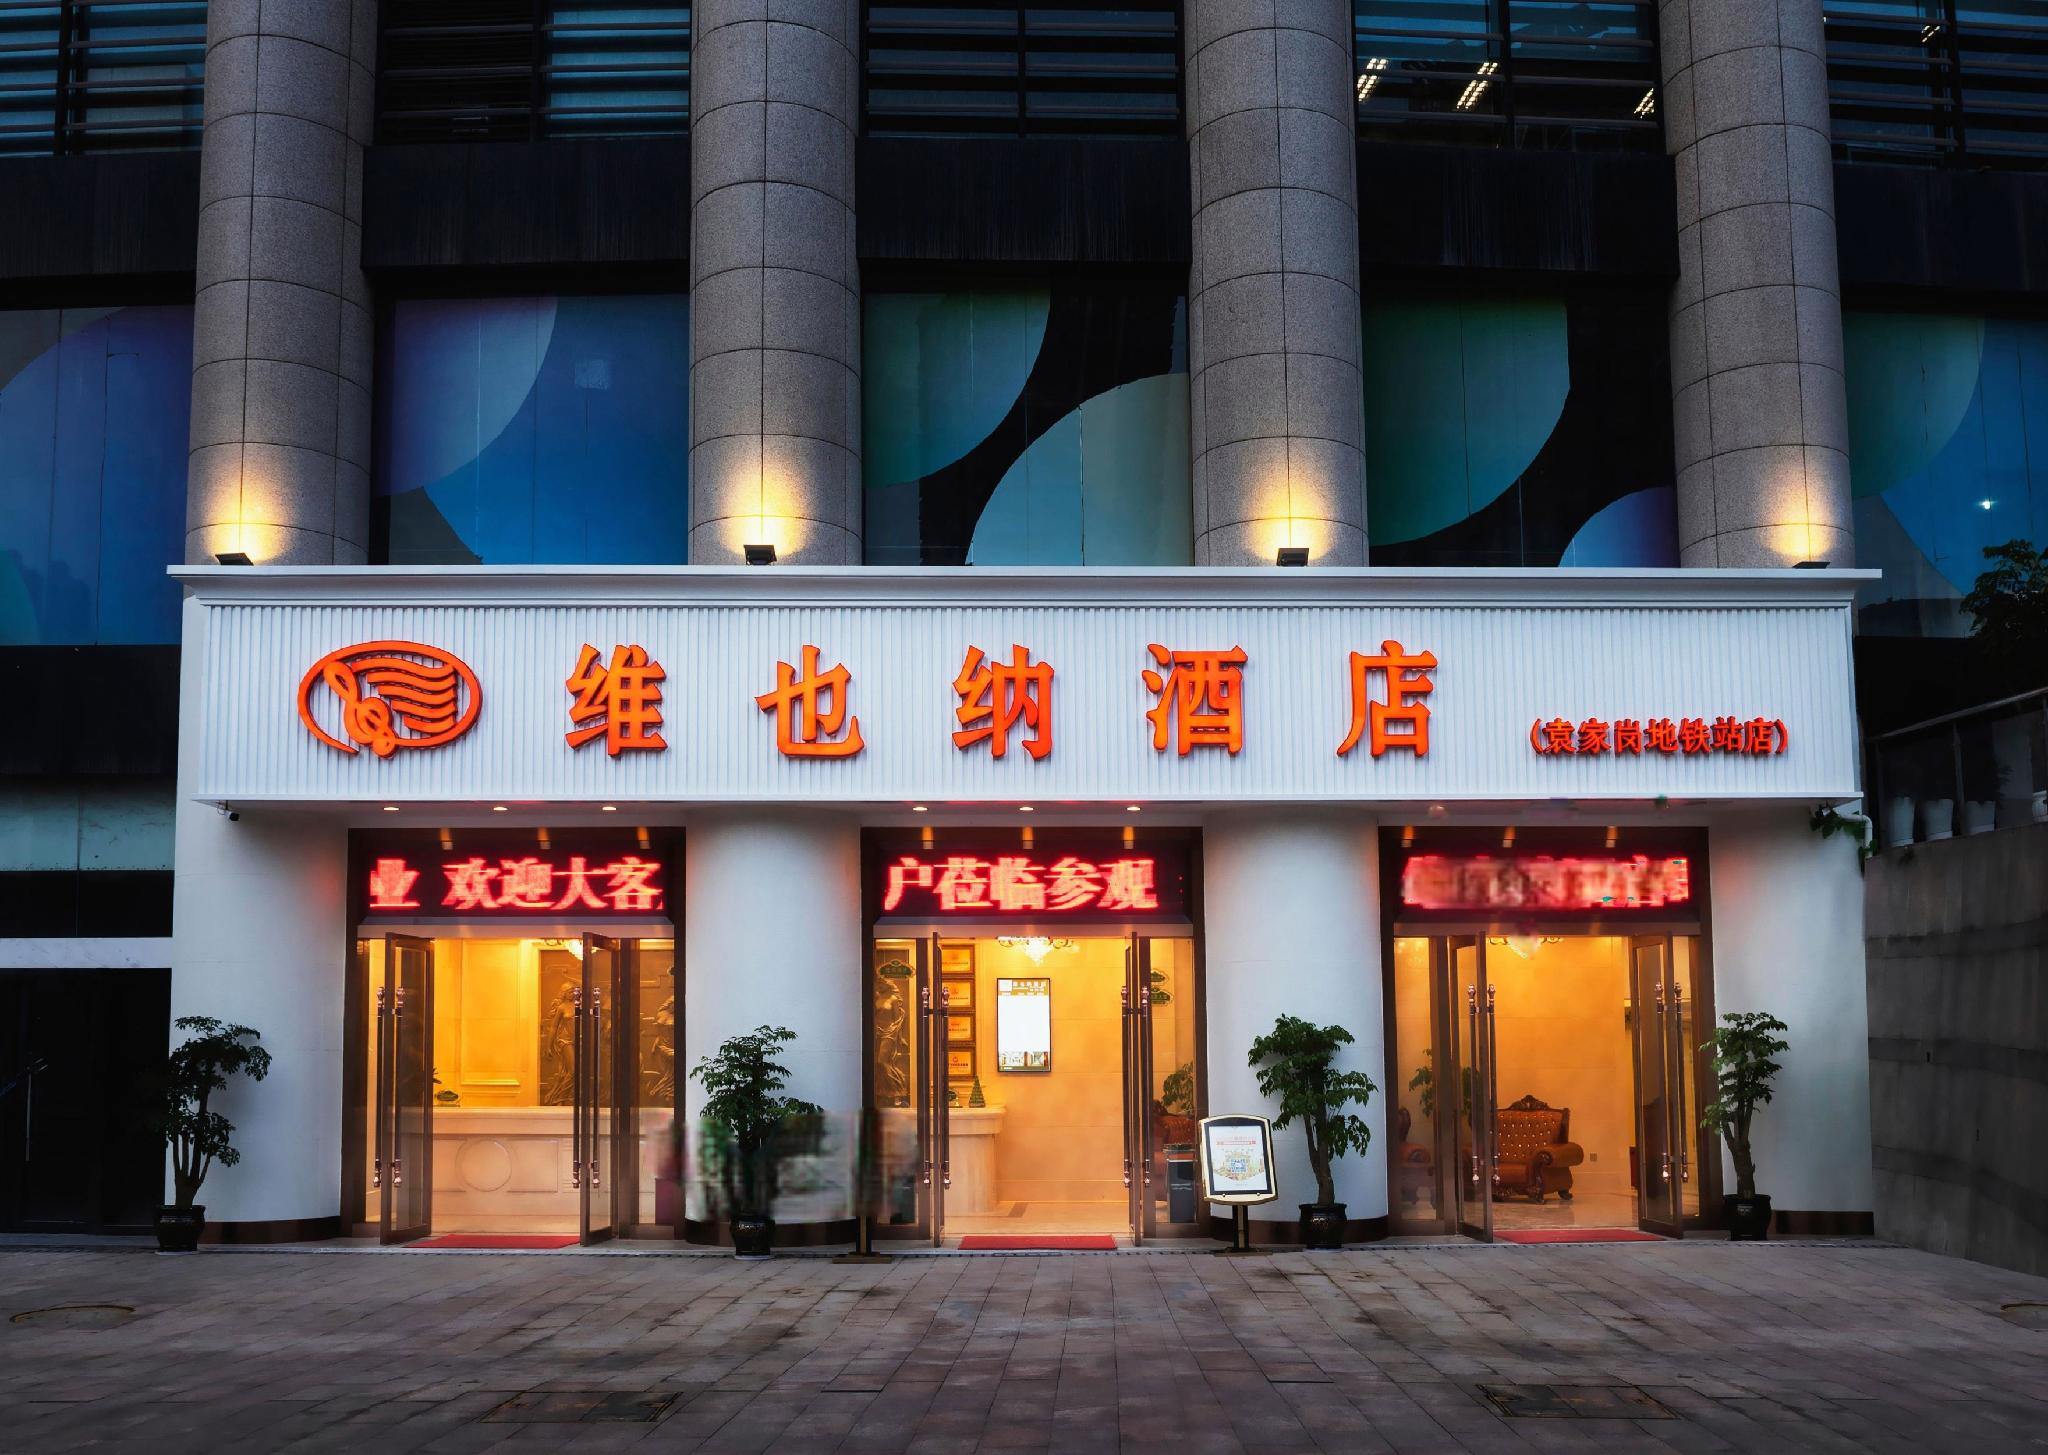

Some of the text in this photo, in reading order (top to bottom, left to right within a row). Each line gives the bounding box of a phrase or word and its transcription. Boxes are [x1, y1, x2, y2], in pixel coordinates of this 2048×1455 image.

[565, 640, 1438, 759] 维也纳酒店
[1530, 716, 1789, 754] (袁家岗地铁站店)
